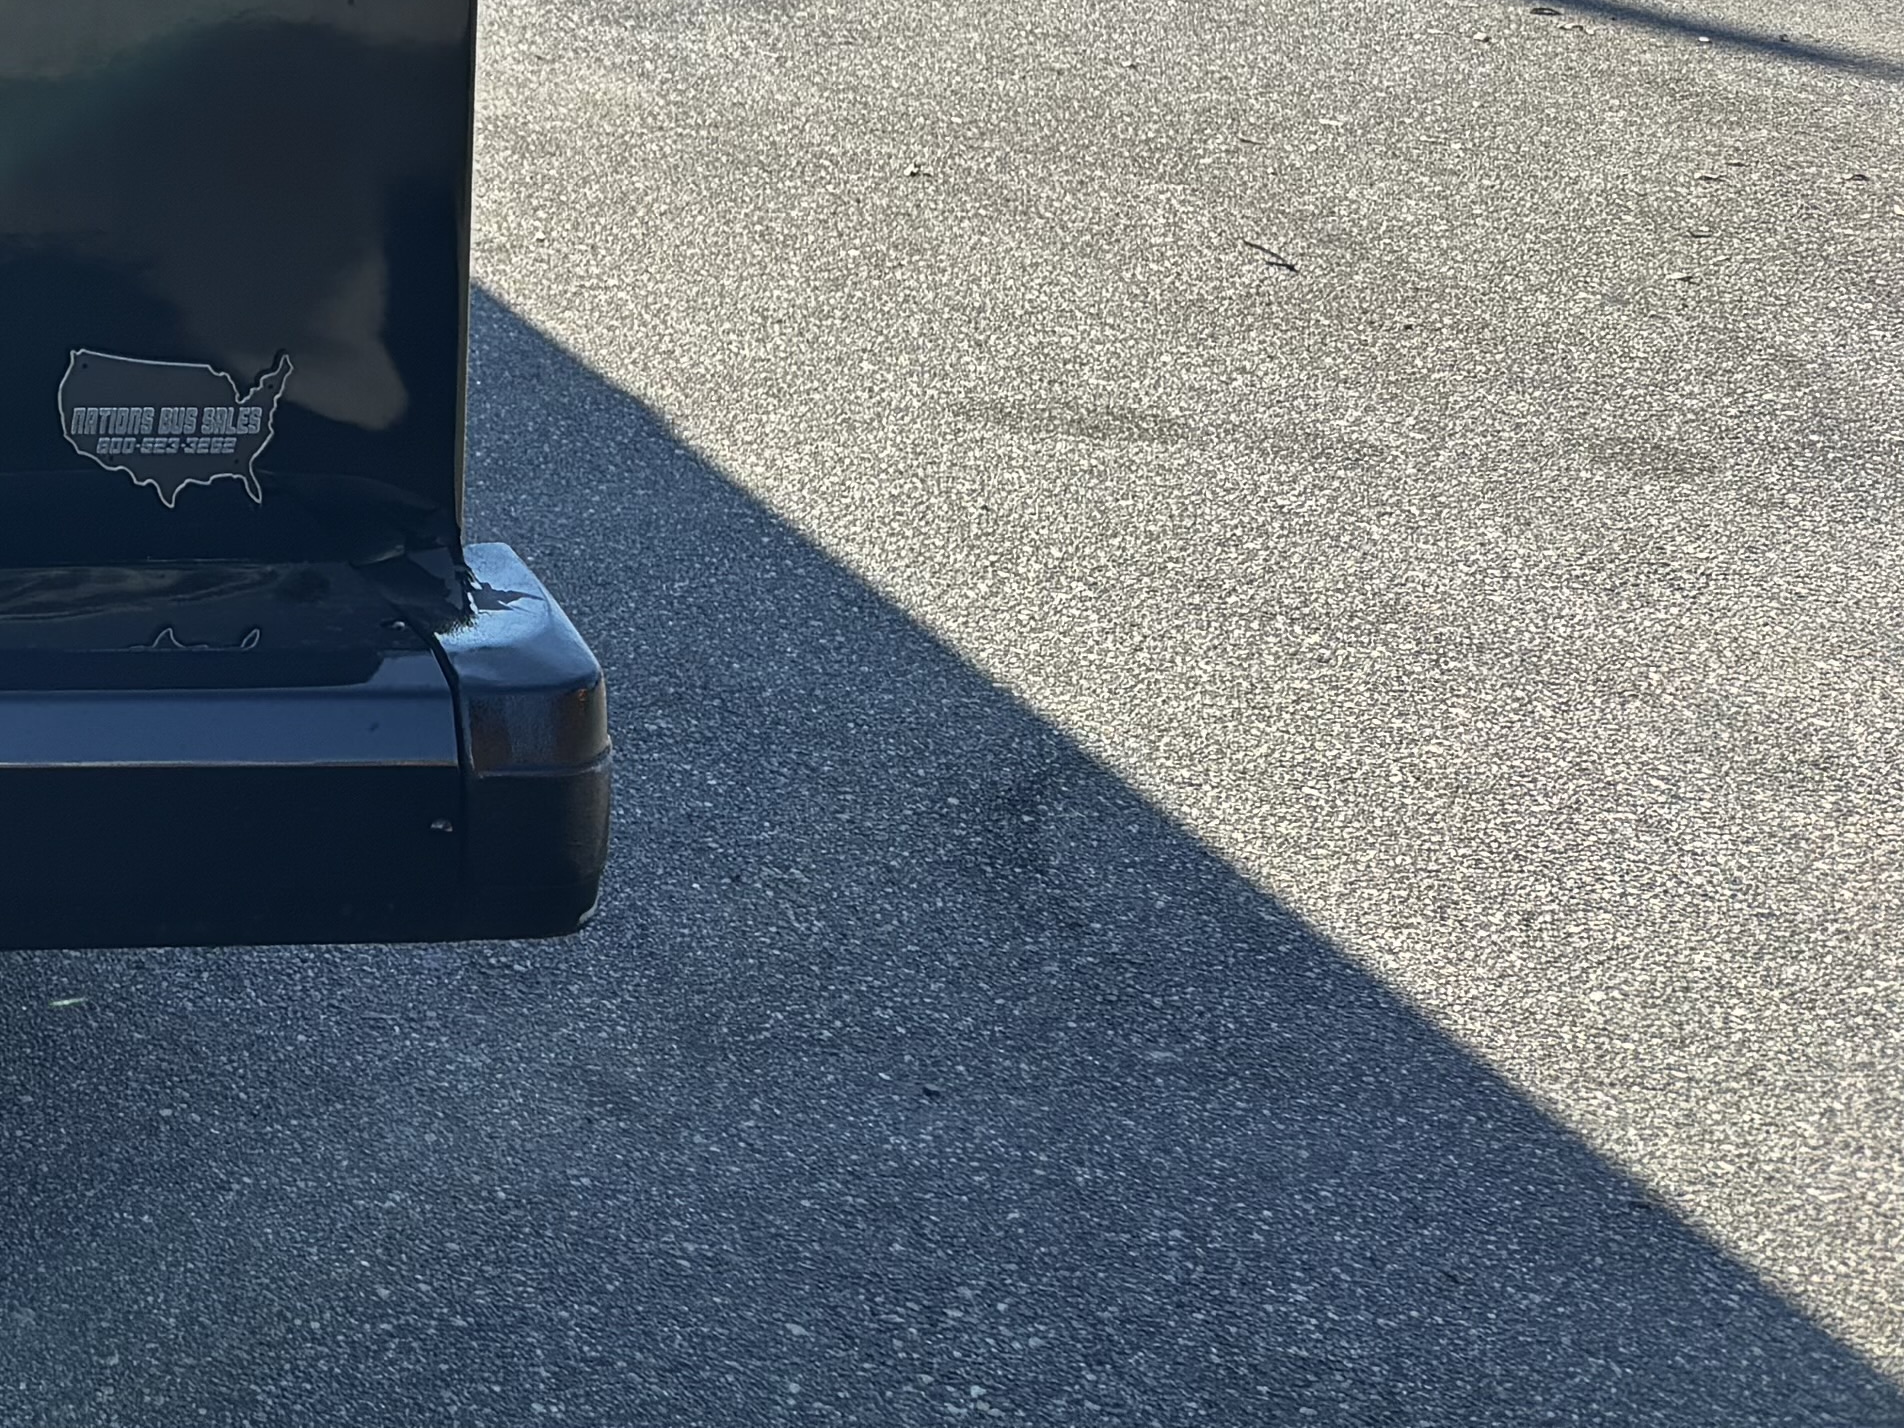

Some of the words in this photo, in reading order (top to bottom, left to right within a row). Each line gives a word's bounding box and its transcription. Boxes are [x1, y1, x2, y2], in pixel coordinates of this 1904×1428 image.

[70, 407, 155, 435] NATIONS
[157, 407, 198, 435] BUS
[201, 407, 263, 435] SALES
